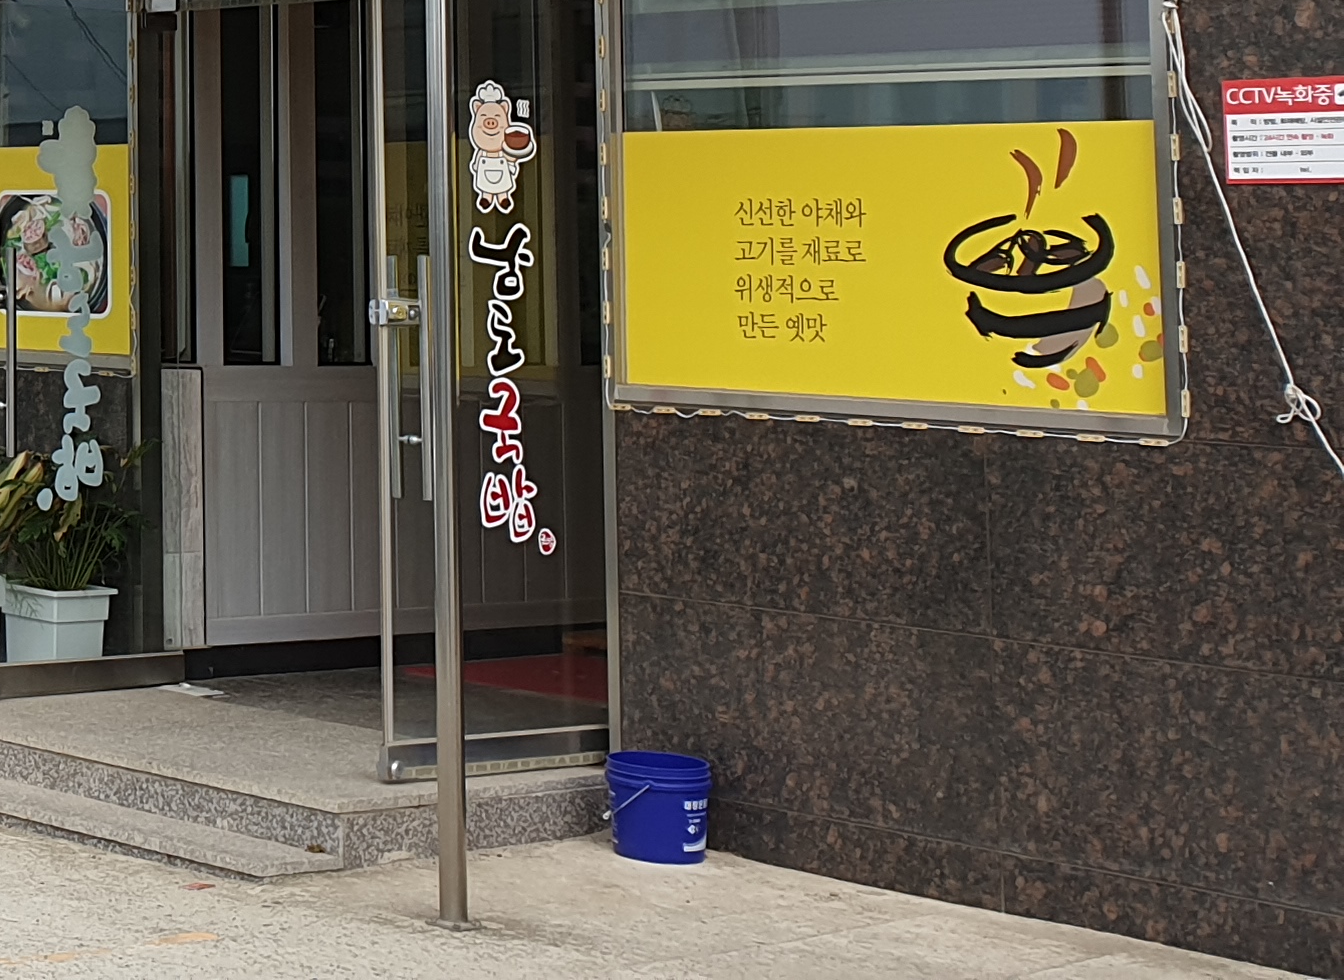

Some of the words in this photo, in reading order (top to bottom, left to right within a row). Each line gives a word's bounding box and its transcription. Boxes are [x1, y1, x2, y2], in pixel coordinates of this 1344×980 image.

[1226, 84, 1334, 106] CCTV녹화중
[734, 198, 796, 227] 신선한
[801, 198, 867, 228] 야채와
[734, 236, 798, 266] 고기를
[801, 236, 867, 266] 재료로
[734, 273, 839, 304] 위생적으로
[737, 311, 780, 339] 만든
[786, 312, 828, 343] 옛맛
[468, 223, 538, 543] 남도국밥
